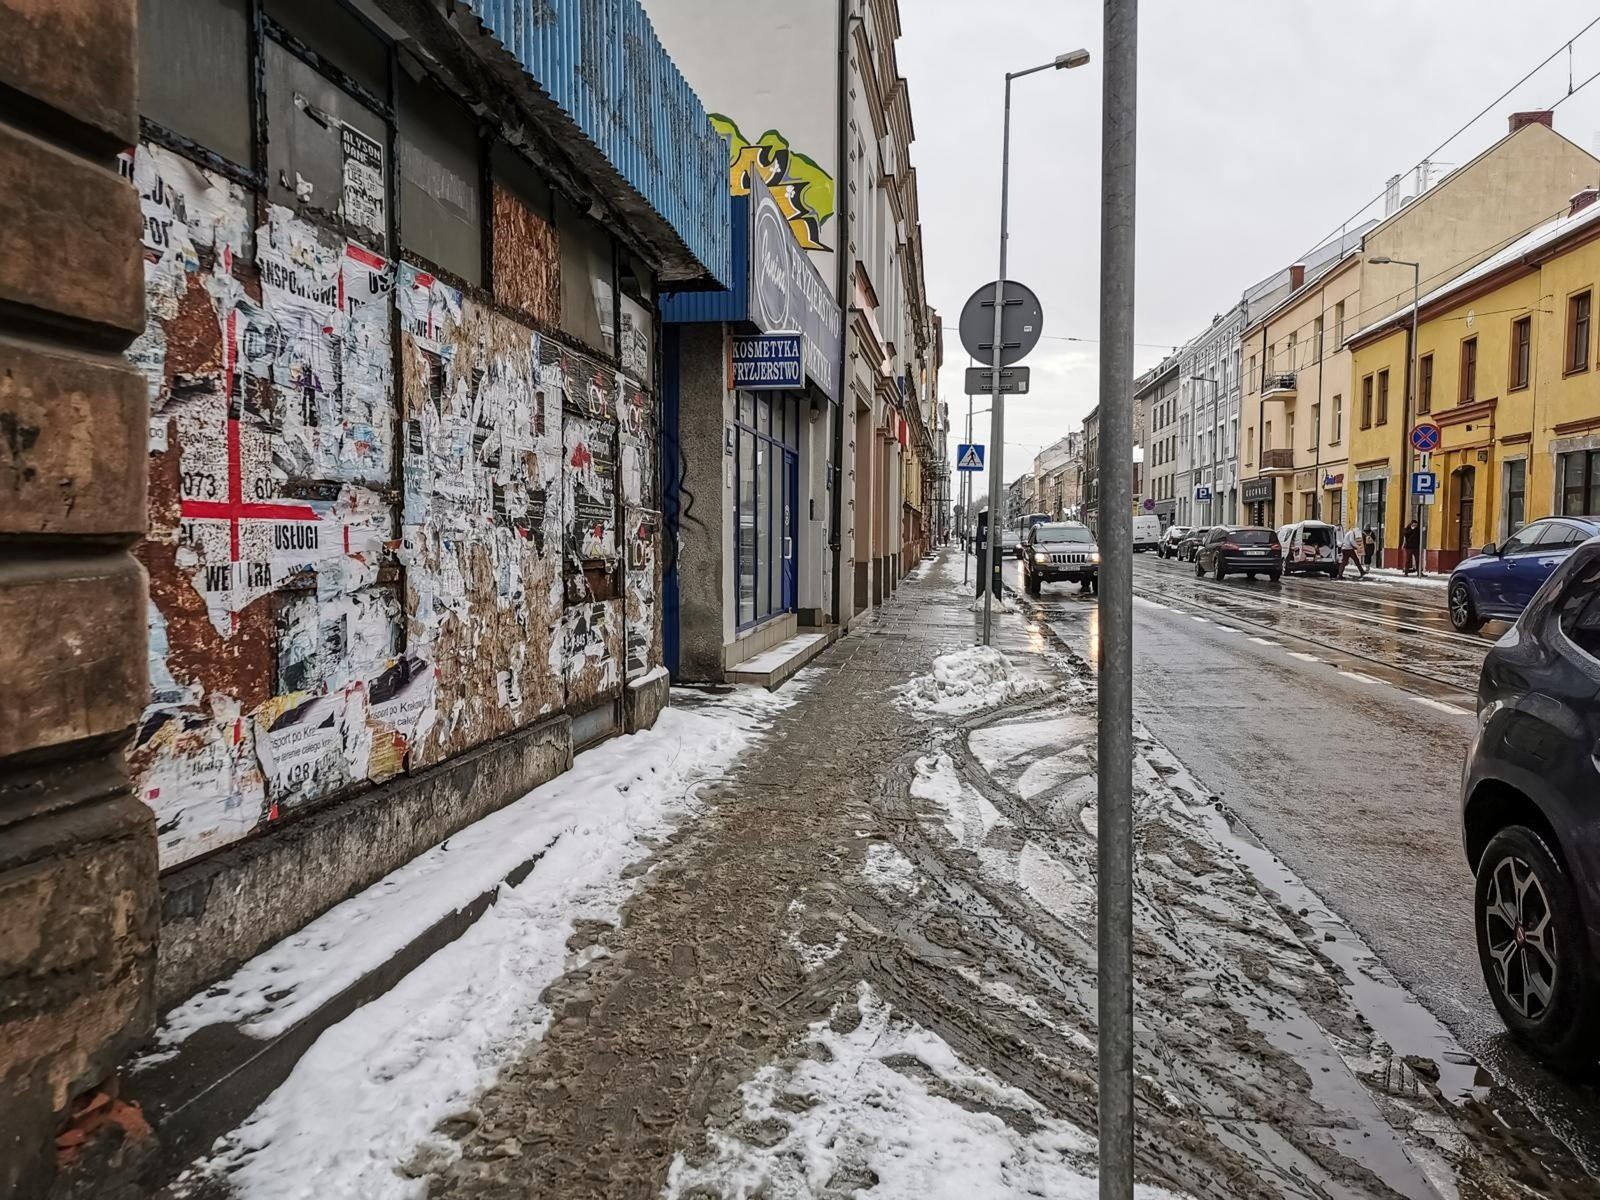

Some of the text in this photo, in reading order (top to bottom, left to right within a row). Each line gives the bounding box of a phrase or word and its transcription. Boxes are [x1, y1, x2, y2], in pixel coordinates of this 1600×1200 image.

[791, 245, 839, 340] FRYZJERSTWO
[732, 340, 800, 359] KOSMETYKA
[732, 361, 799, 381] FRYZJERSTWO
[1417, 475, 1431, 491] P
[274, 525, 319, 550] USŁUGI
